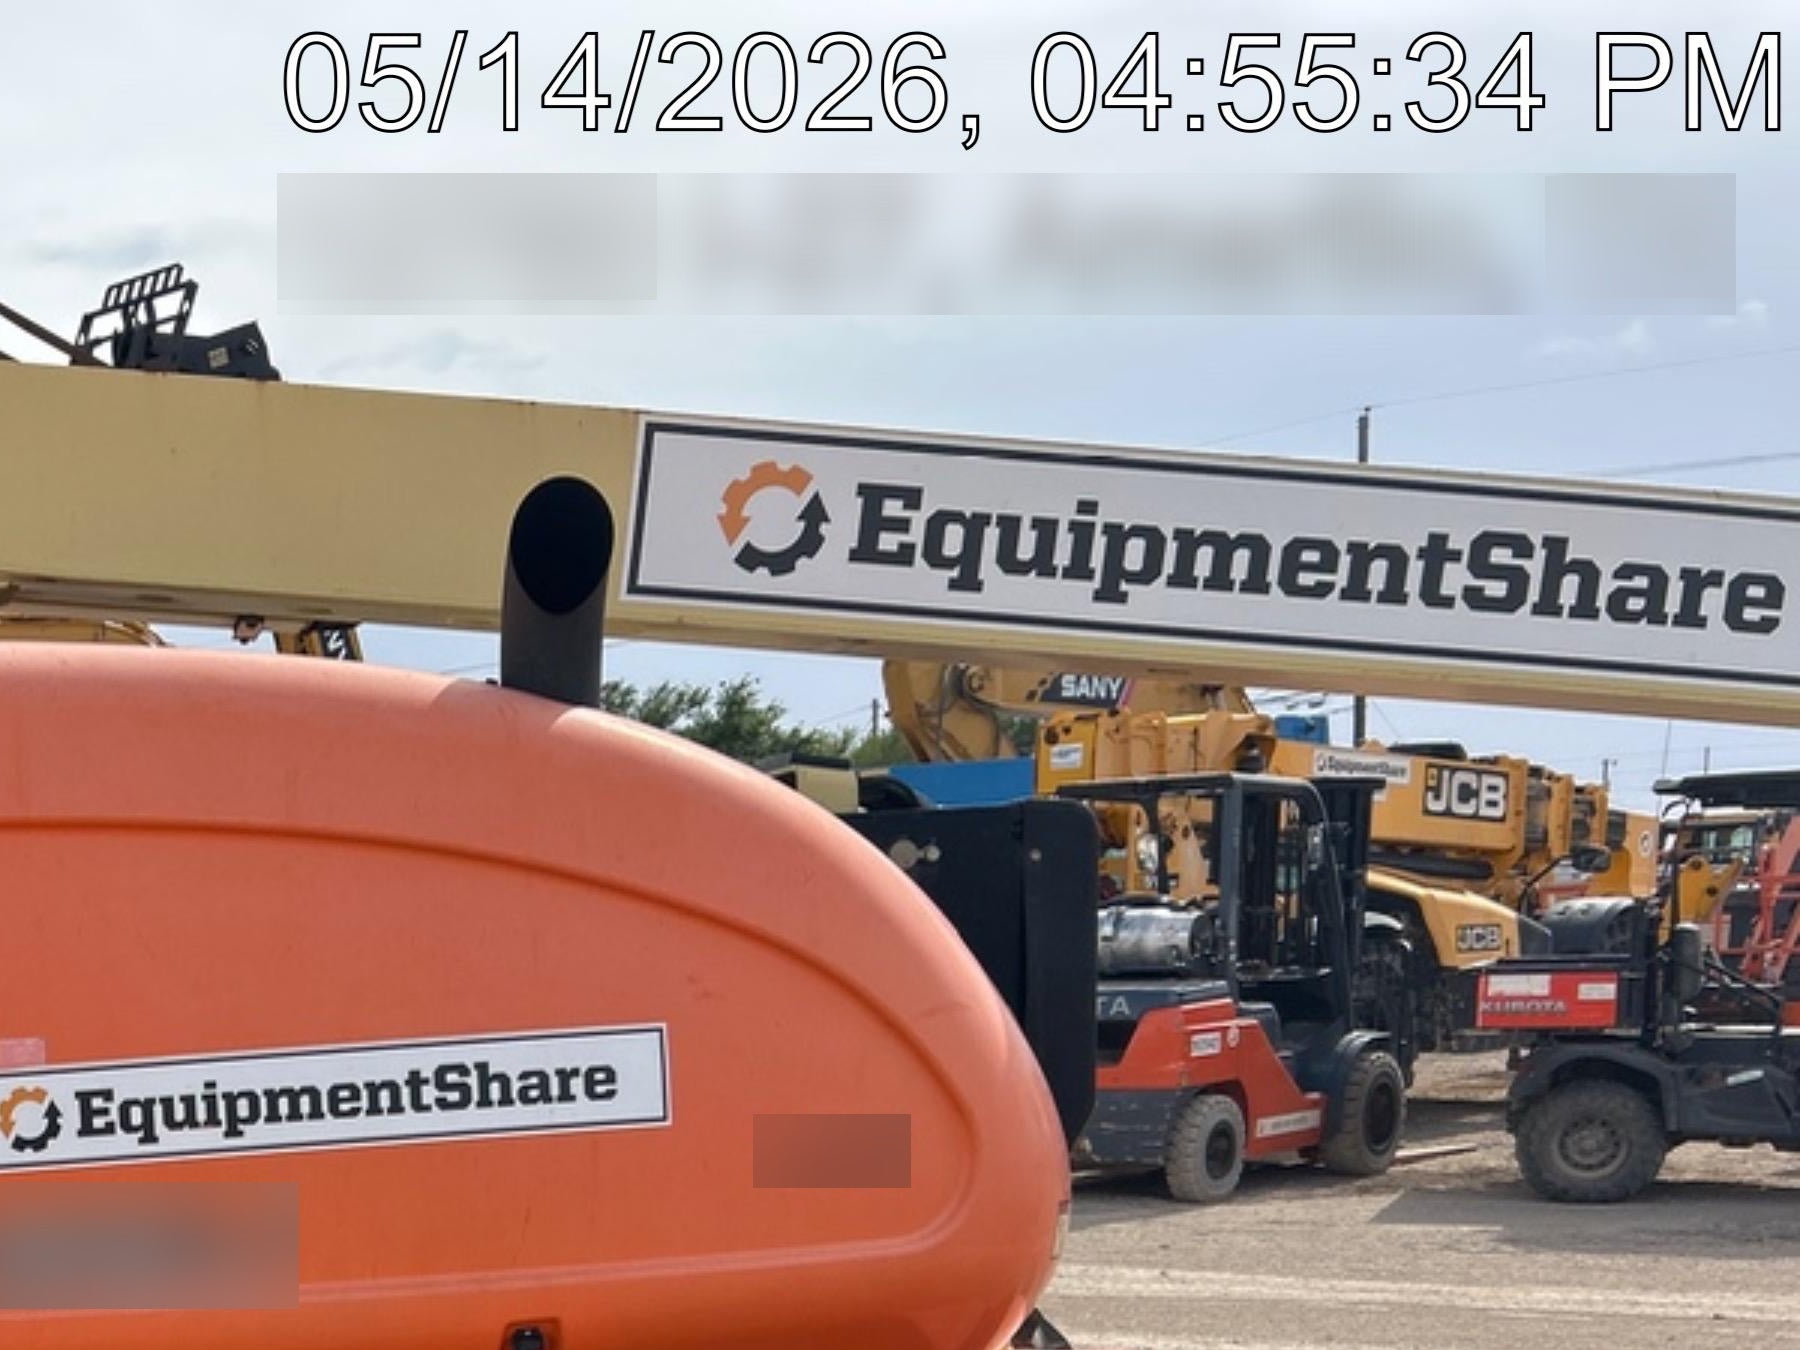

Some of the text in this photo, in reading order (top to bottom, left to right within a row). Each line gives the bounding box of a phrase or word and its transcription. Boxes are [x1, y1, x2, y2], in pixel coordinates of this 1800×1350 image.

[847, 481, 1785, 635] EquipmentShare
[1061, 674, 1123, 700] SANY
[1426, 768, 1507, 818] JCB
[1457, 925, 1500, 950] JCB
[73, 1061, 619, 1144] EquipmentShare
